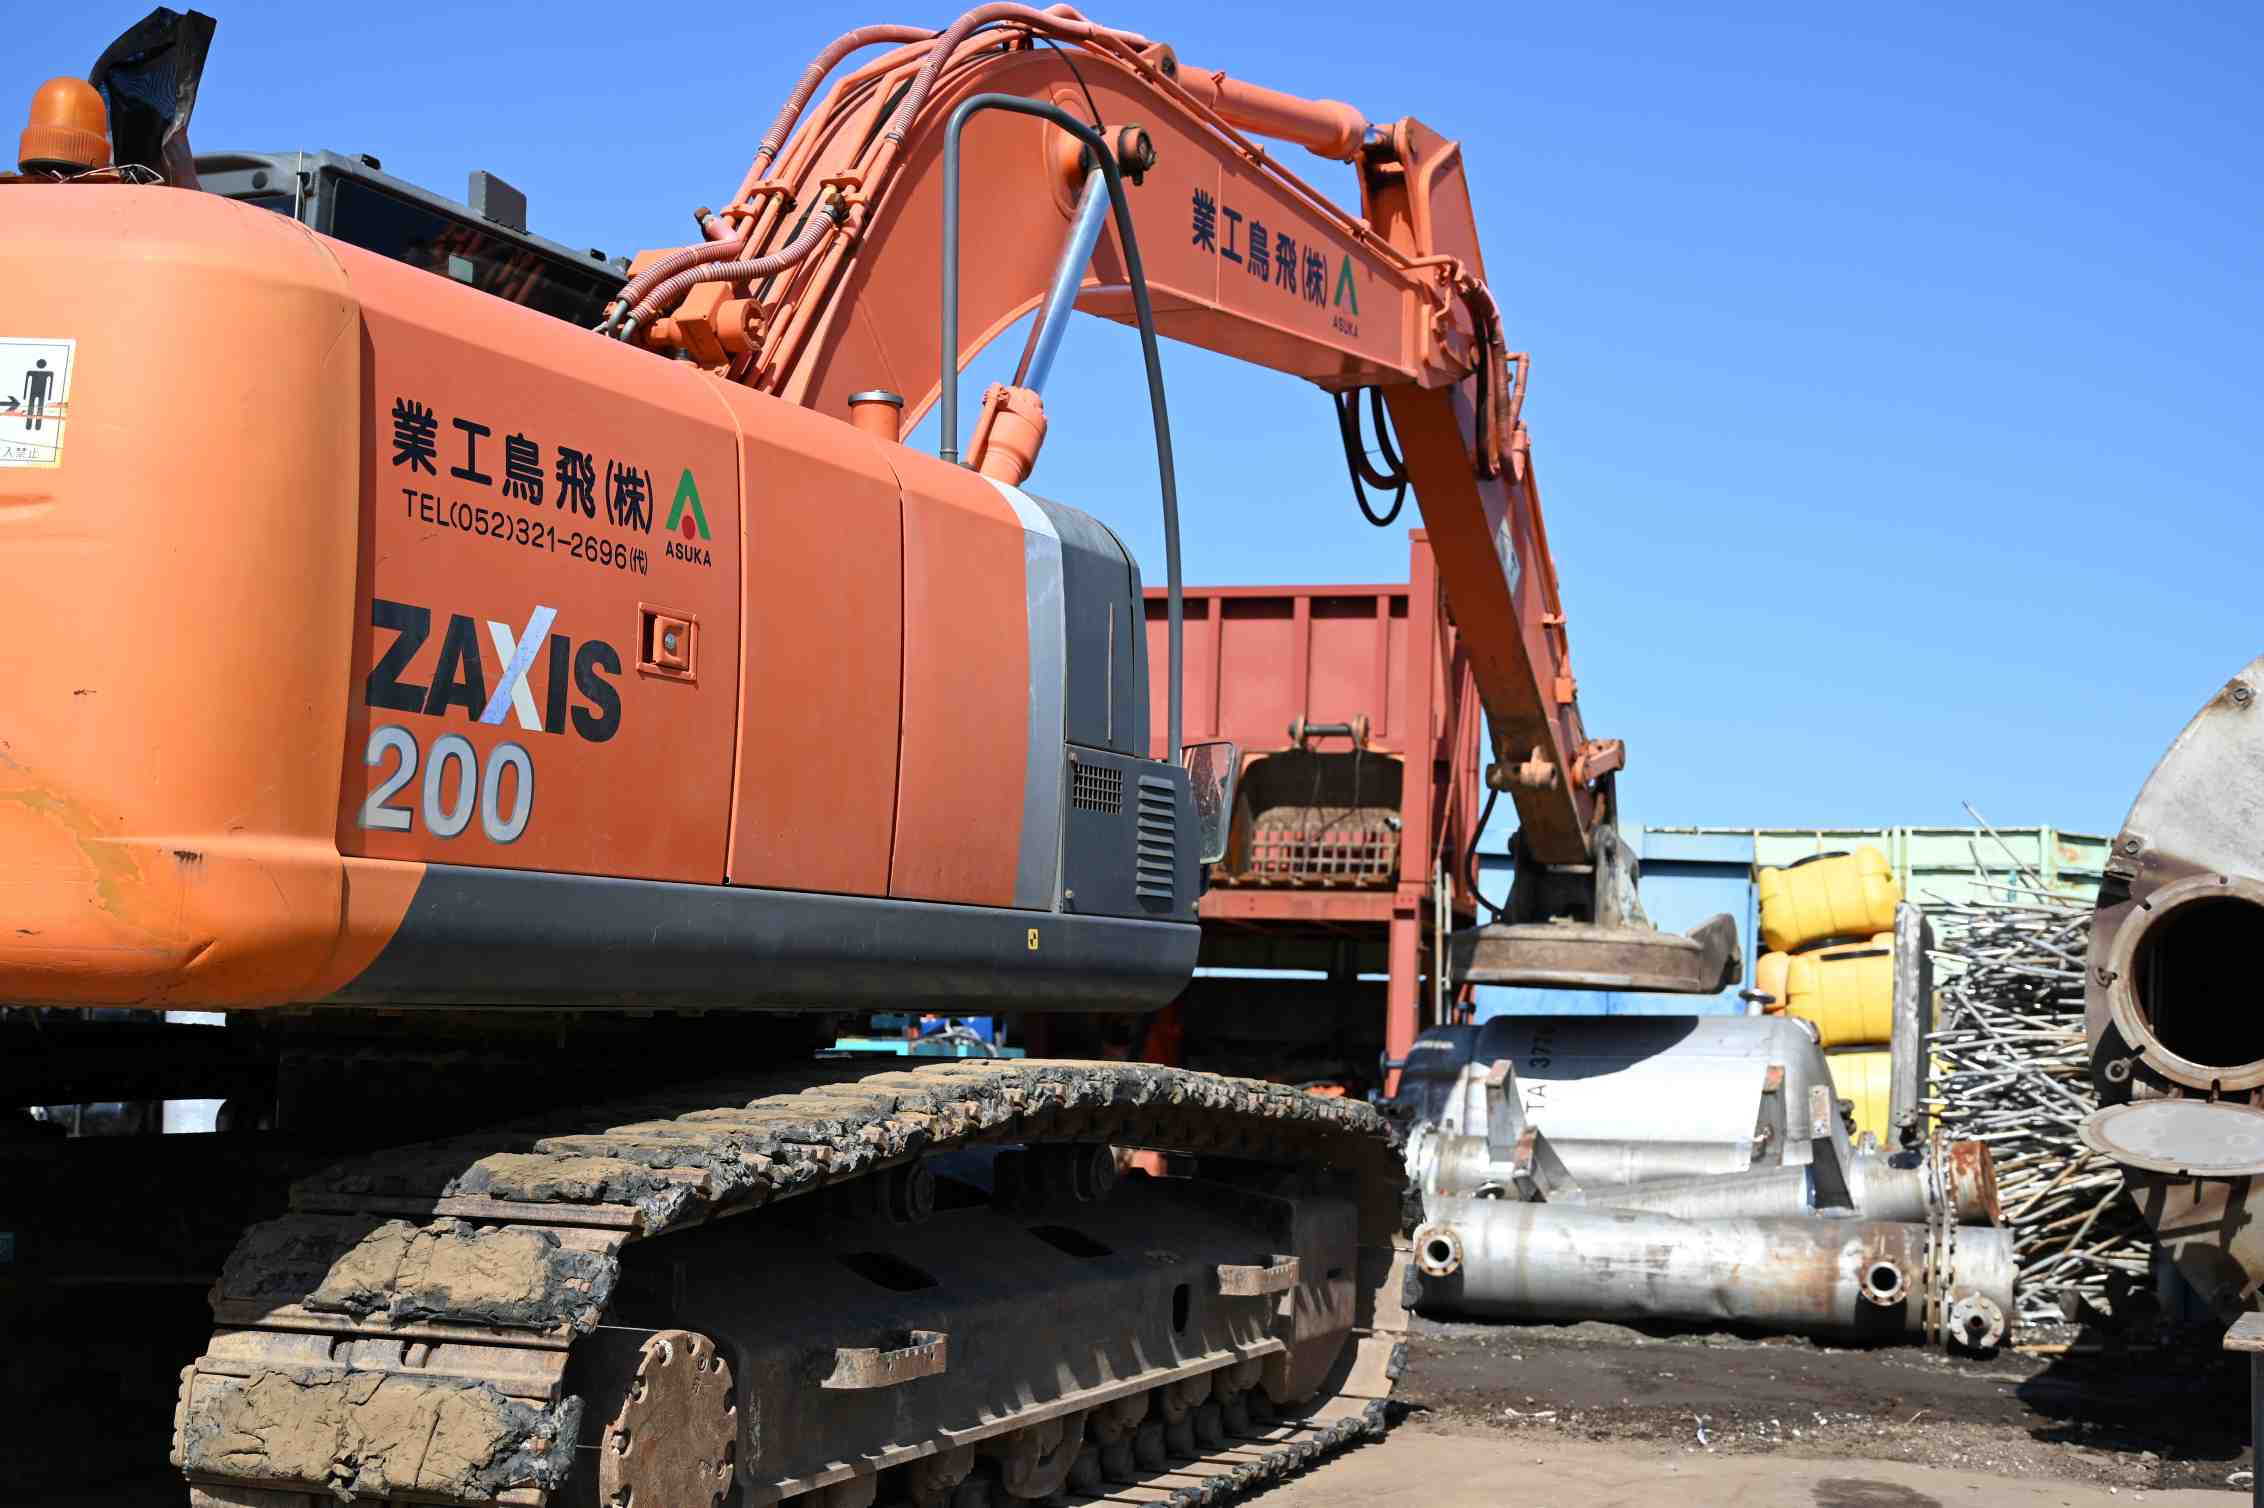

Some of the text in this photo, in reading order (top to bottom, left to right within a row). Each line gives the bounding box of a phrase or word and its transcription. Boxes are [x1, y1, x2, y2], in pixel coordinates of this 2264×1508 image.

[1191, 187, 1328, 309] 業工鳥飛(株)
[1332, 315, 1359, 337] ASUKA
[392, 397, 653, 534] 業工鳥飛(株)
[665, 540, 712, 568] ASUKA
[365, 598, 622, 742] ZAXIS
[357, 724, 535, 844] 200
